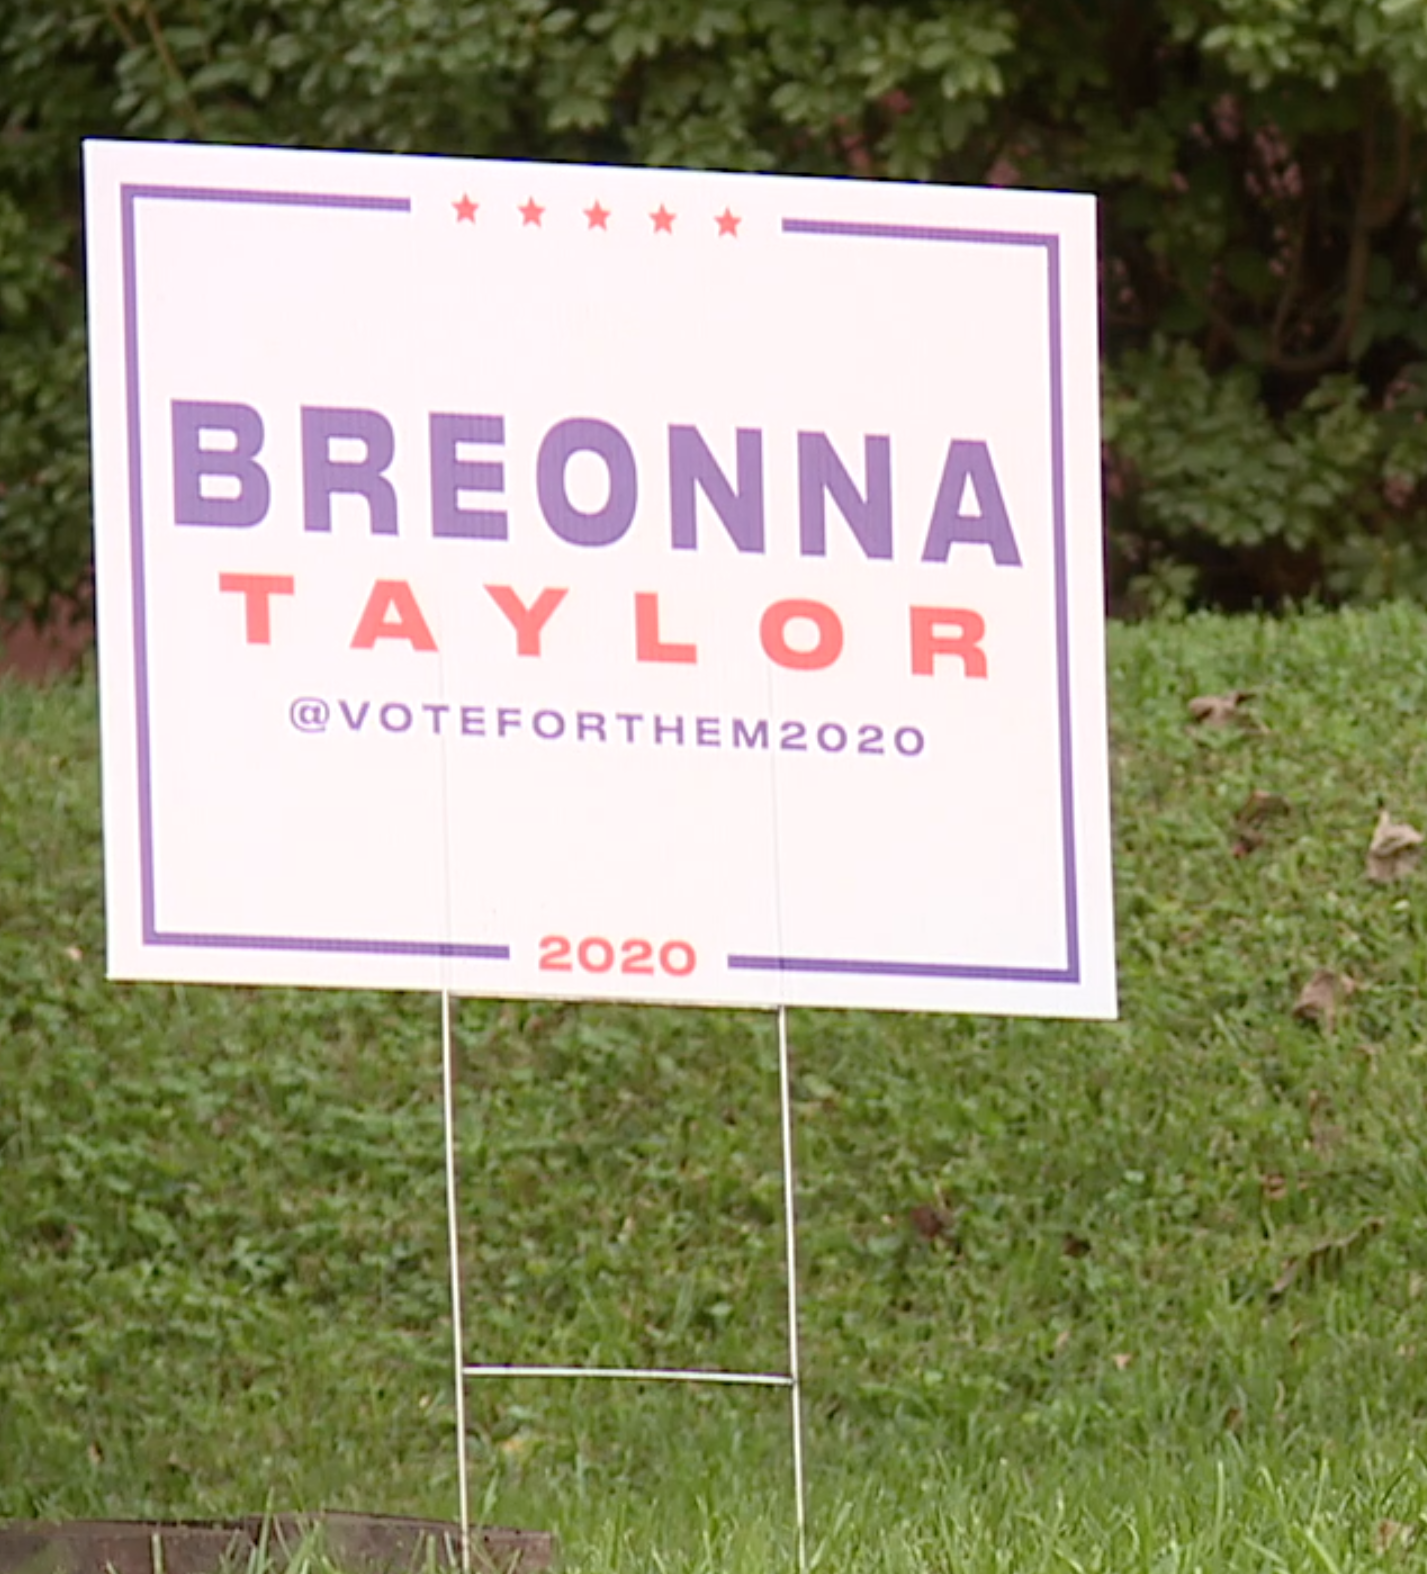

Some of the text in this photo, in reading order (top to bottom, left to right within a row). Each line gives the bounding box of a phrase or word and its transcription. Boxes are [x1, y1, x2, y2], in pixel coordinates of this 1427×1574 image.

[170, 398, 1023, 567] BREONNA
[218, 572, 989, 680] TAYLOR
[289, 696, 926, 758] @VOTEFORTHEM2020
[538, 934, 697, 977] 2020
